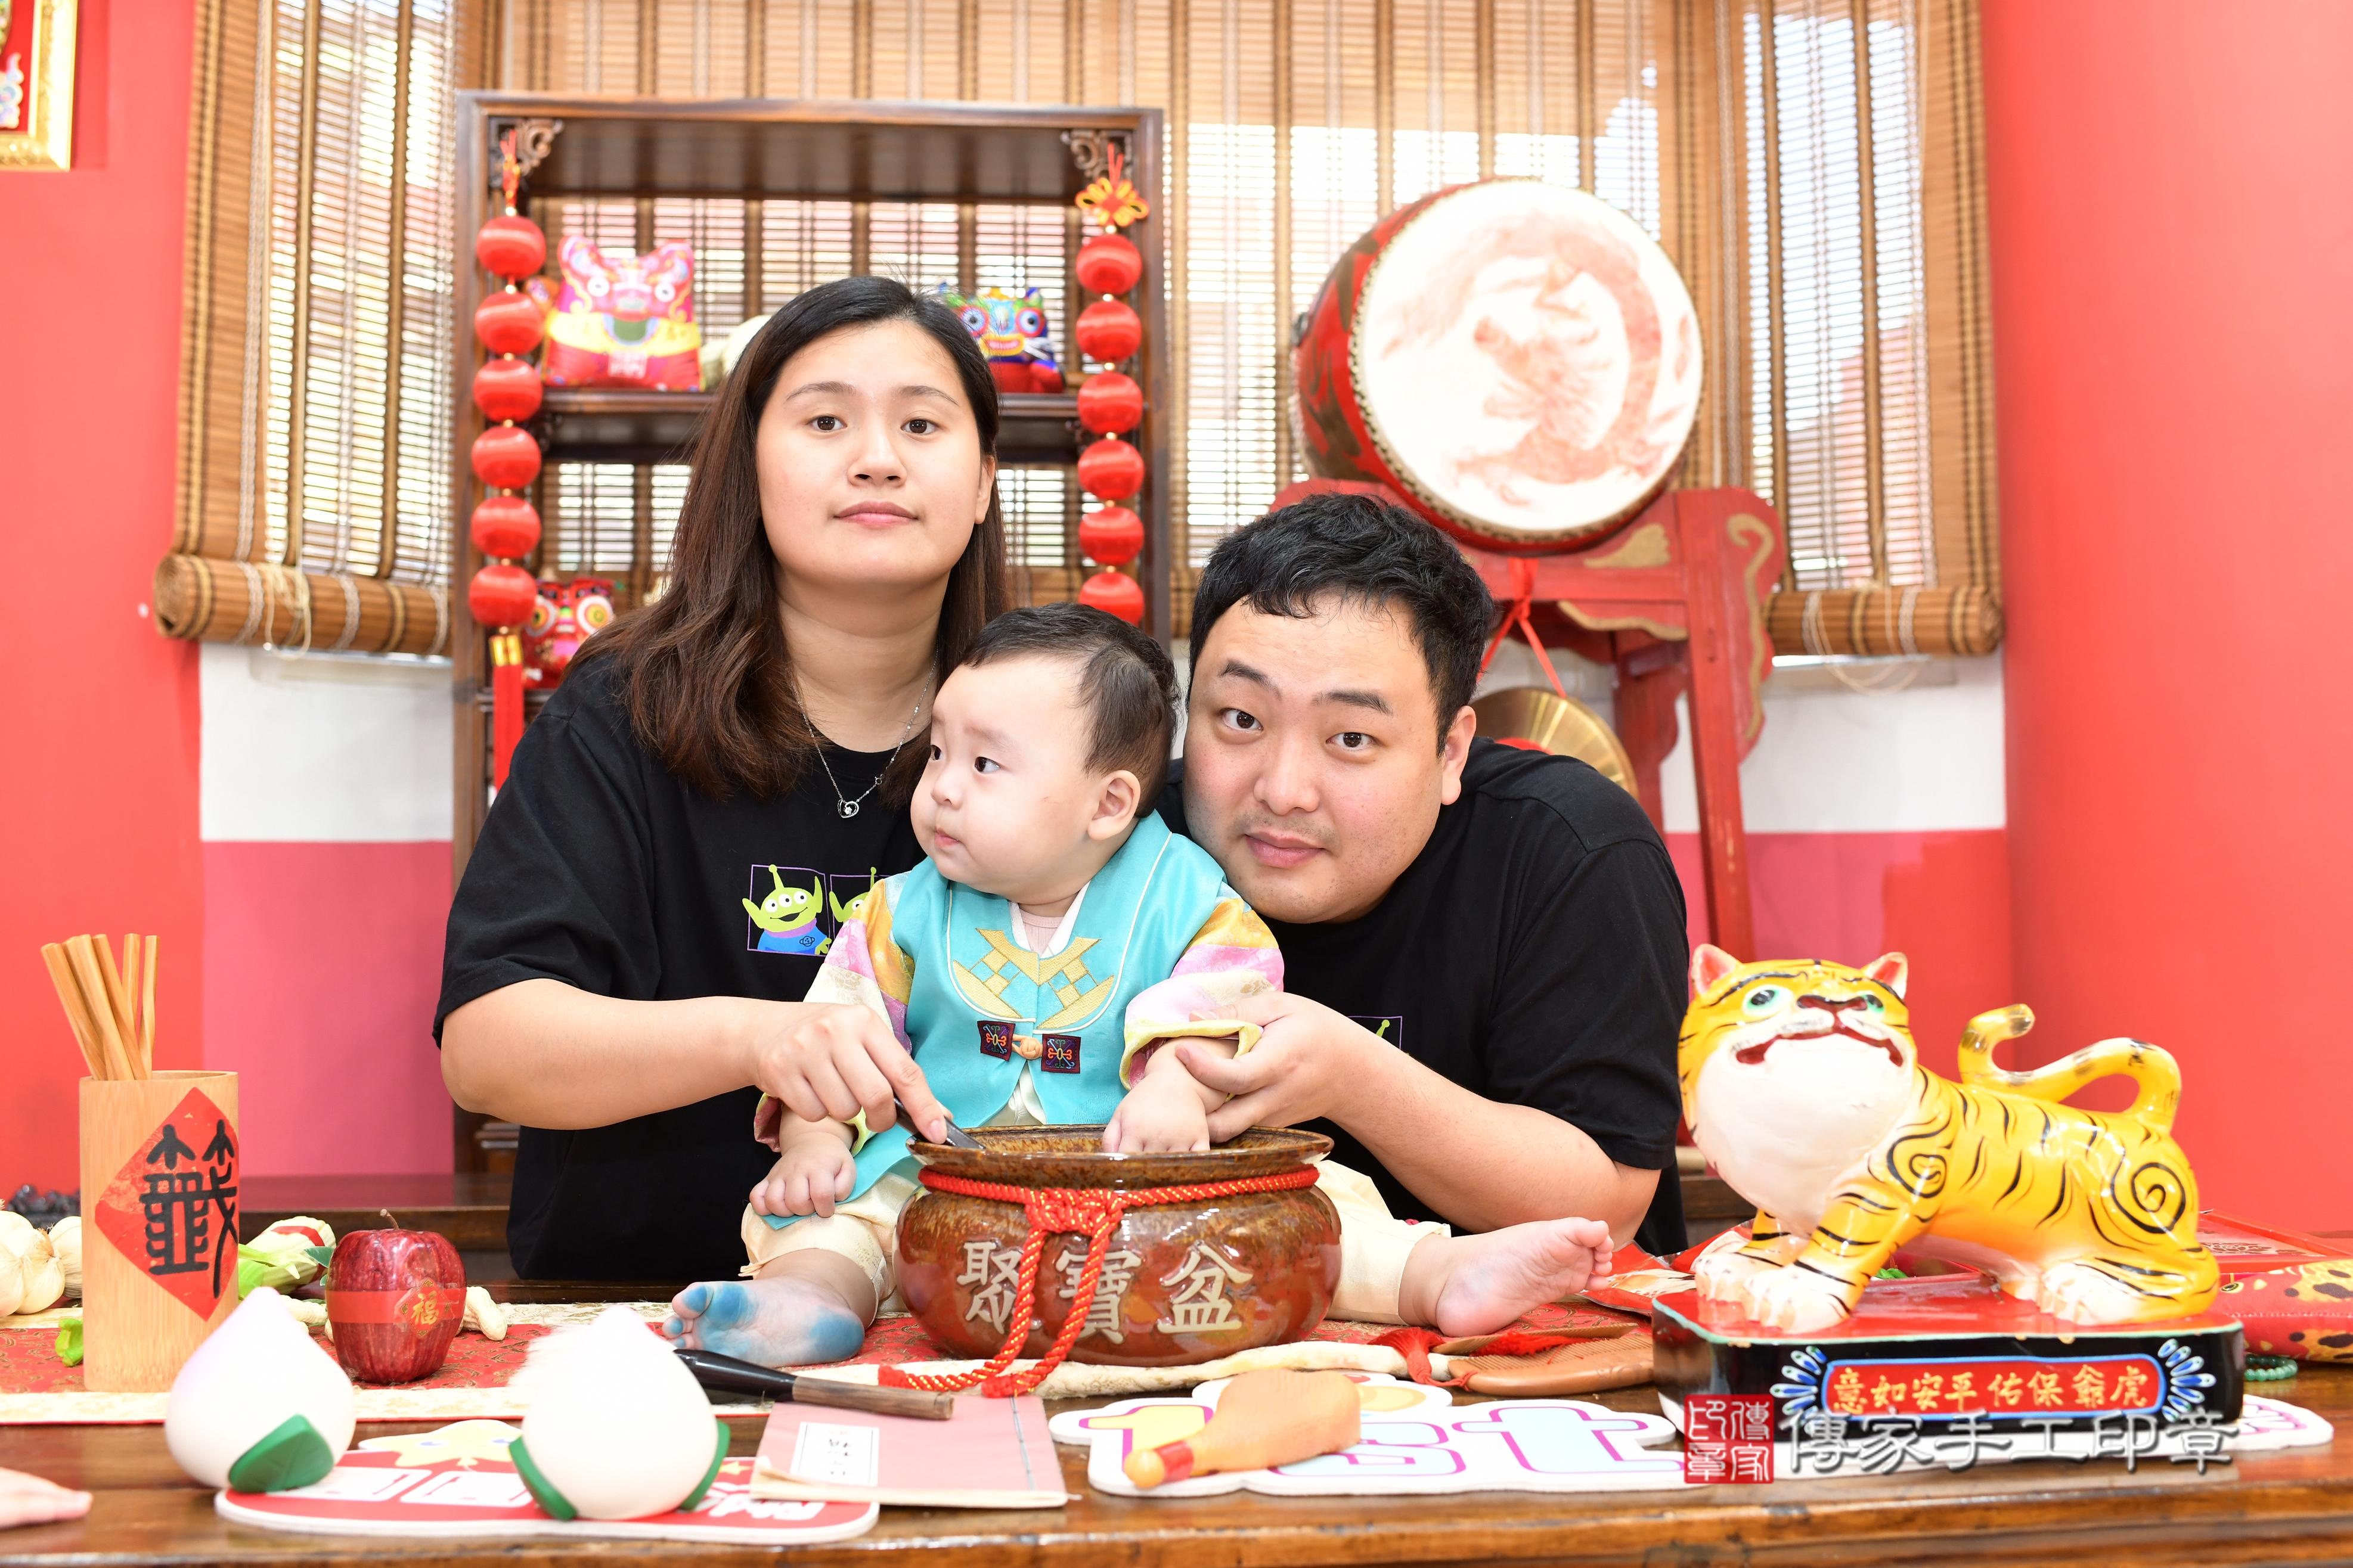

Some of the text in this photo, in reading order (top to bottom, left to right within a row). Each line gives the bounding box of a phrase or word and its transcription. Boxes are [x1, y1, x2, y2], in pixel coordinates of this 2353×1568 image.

[411, 1290, 439, 1325] 福
[957, 1240, 1253, 1345] 聚寶盆
